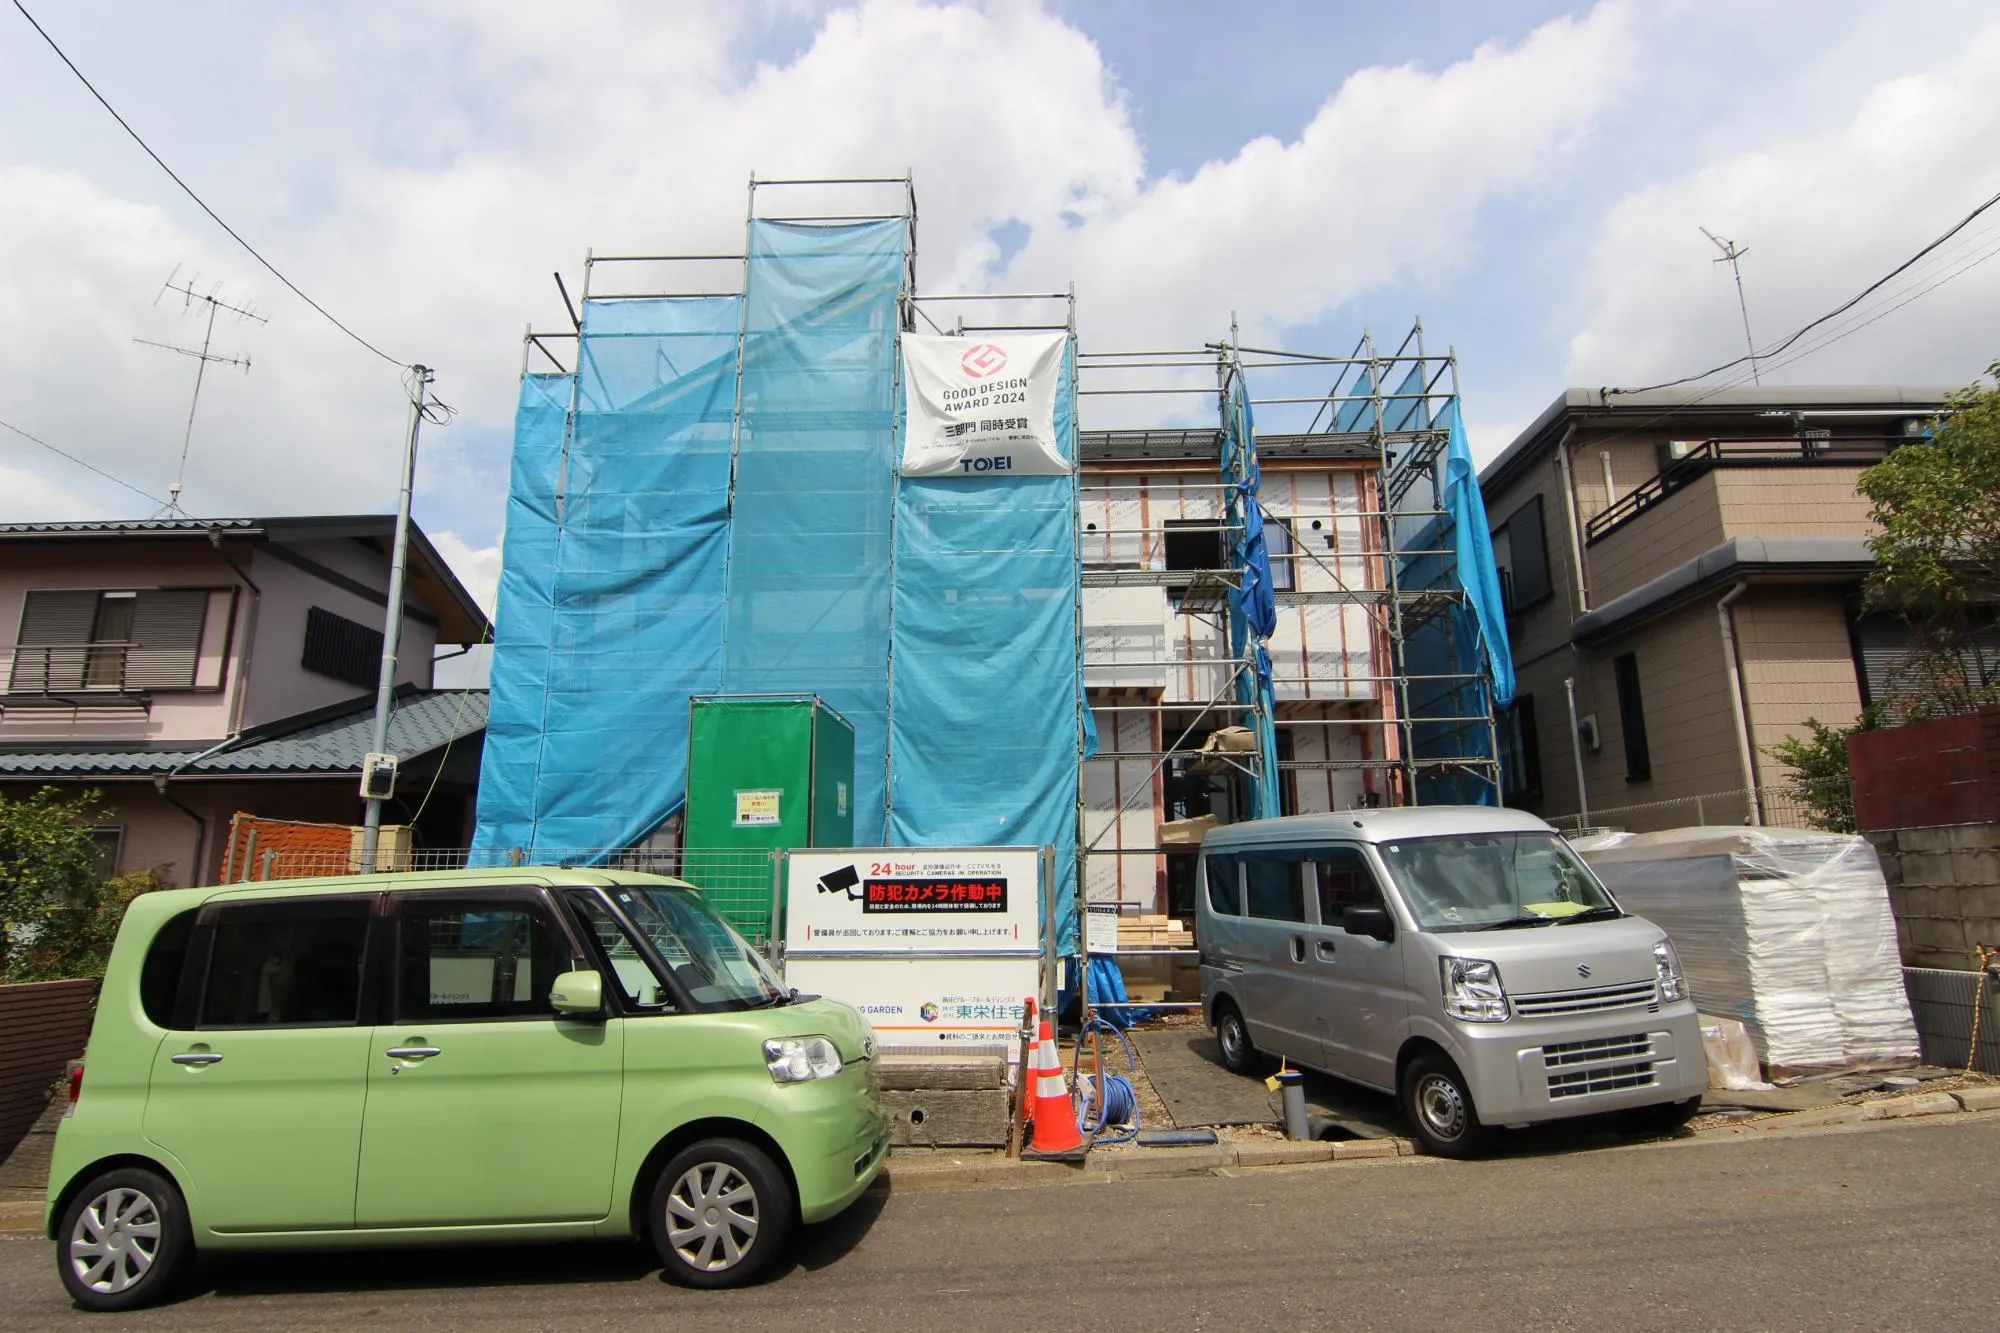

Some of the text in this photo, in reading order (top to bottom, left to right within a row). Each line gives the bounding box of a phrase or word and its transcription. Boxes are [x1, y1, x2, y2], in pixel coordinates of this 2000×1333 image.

[943, 378, 1028, 400] GOOD DESIGN
[944, 392, 1025, 412] AWARD 2024
[945, 418, 1028, 438] 三部門 同時受賞
[960, 456, 1012, 472] TOEI
[870, 862, 916, 876] 24 hour
[869, 883, 1002, 901] 防犯カメラ作動中
[867, 1005, 903, 1014] GARDEN
[956, 1005, 1024, 1020] 東栄住宅
